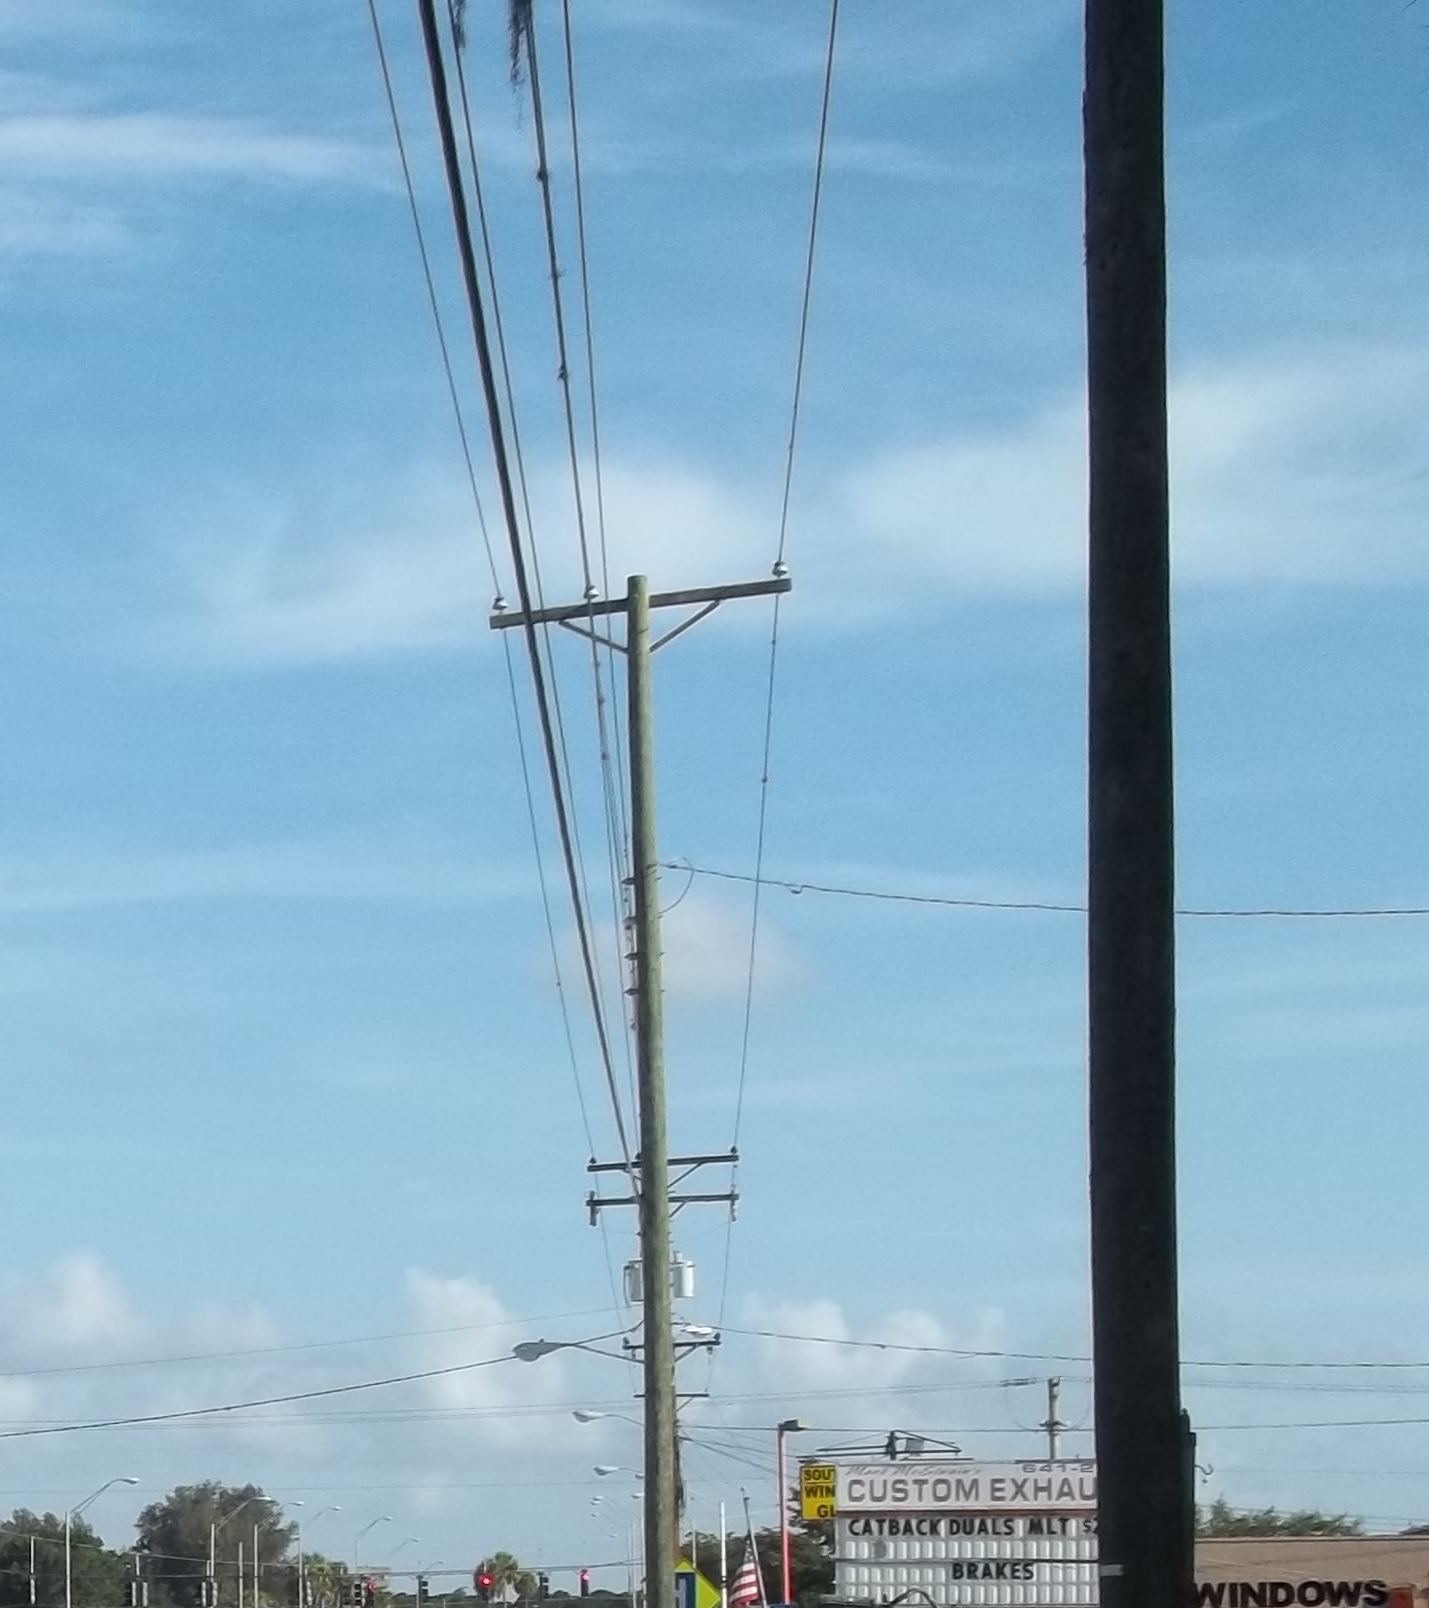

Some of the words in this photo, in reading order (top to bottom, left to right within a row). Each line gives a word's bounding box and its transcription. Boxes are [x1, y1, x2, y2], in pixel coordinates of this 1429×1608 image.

[804, 1484, 835, 1499] WIN
[848, 1478, 980, 1502] CUSTOM
[992, 1477, 1098, 1502] EXHAU
[847, 1518, 941, 1537] CATBACK
[949, 1517, 1015, 1536] DUALS
[1028, 1517, 1070, 1536] MLT
[952, 1561, 1035, 1581] BRAKES
[1193, 1579, 1389, 1608] WINDOWS
